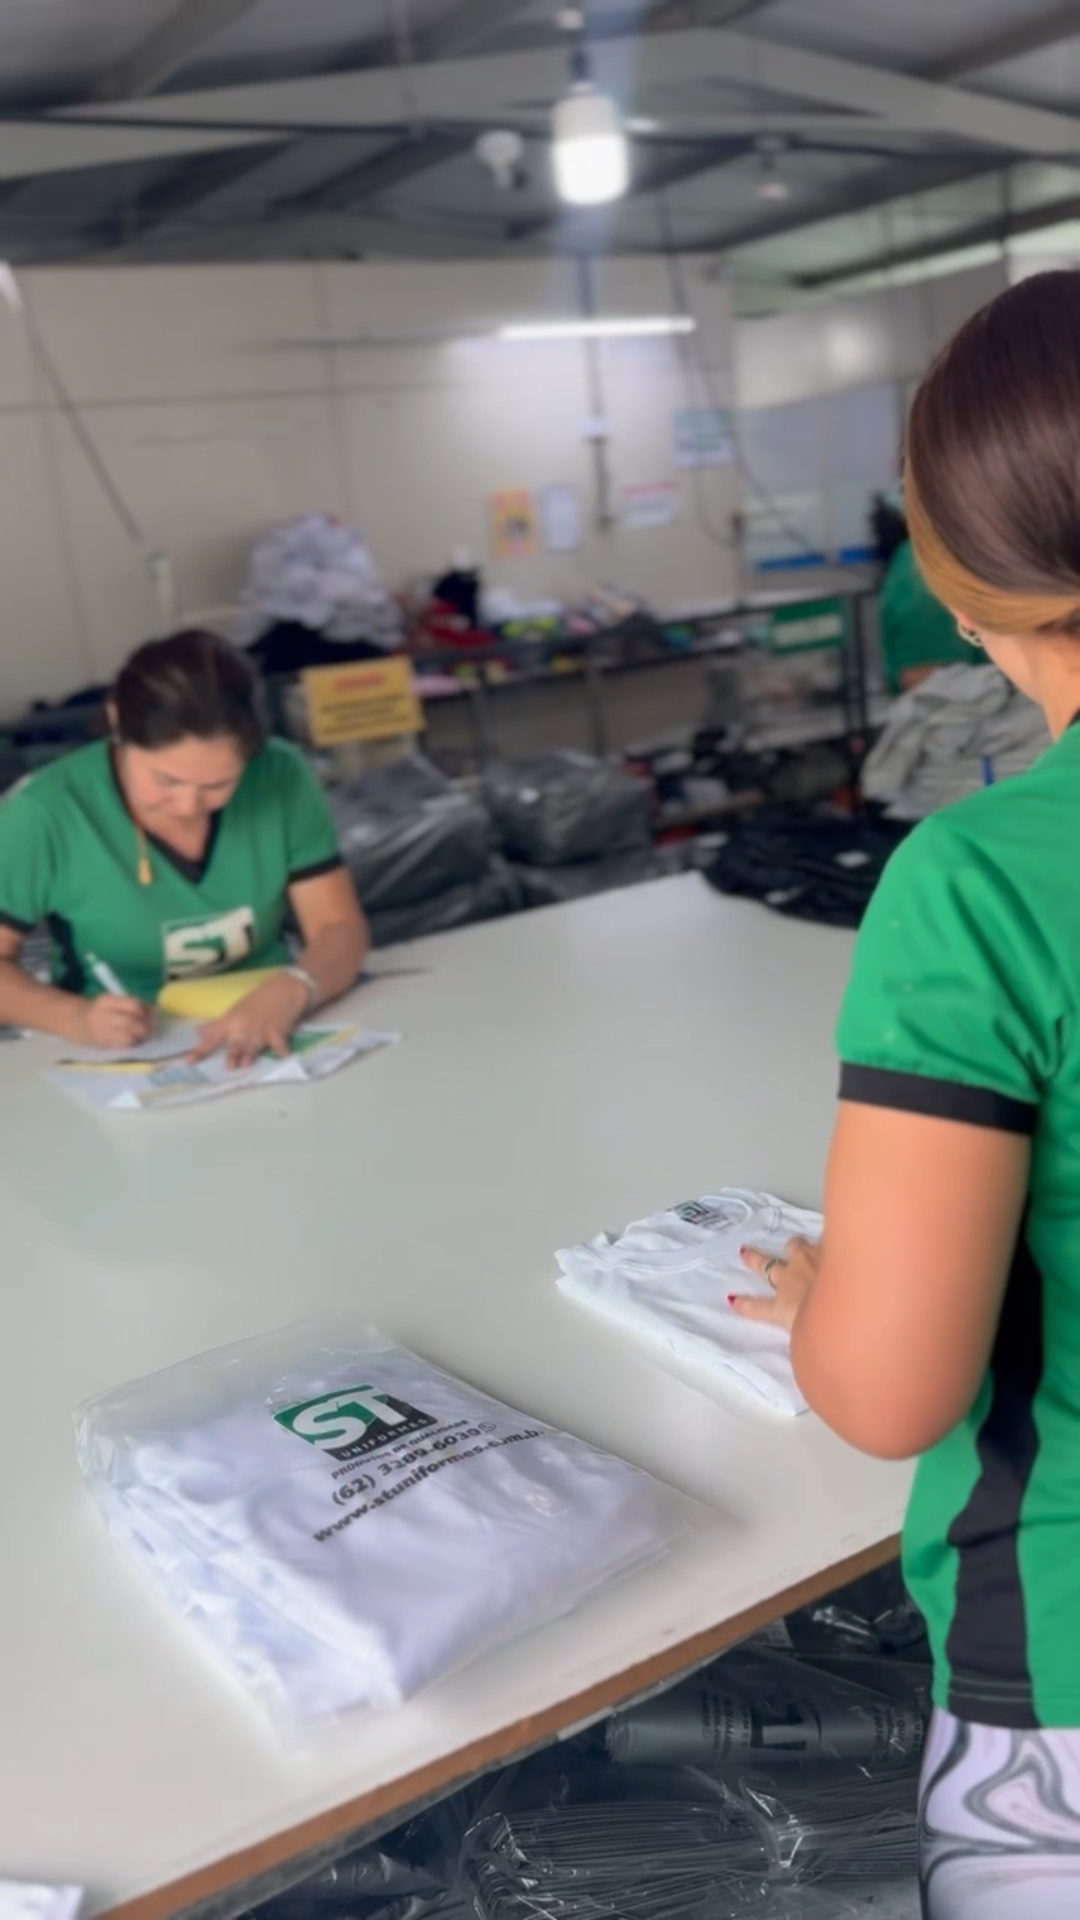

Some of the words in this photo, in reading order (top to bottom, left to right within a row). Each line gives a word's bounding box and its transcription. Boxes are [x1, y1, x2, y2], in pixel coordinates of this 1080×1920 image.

[163, 905, 254, 973] ST
[290, 1388, 409, 1450] ST
[341, 1418, 429, 1459] UNIFORMES
[312, 1429, 545, 1543] www.stuniformes.com.b
[332, 1473, 377, 1506] (62)
